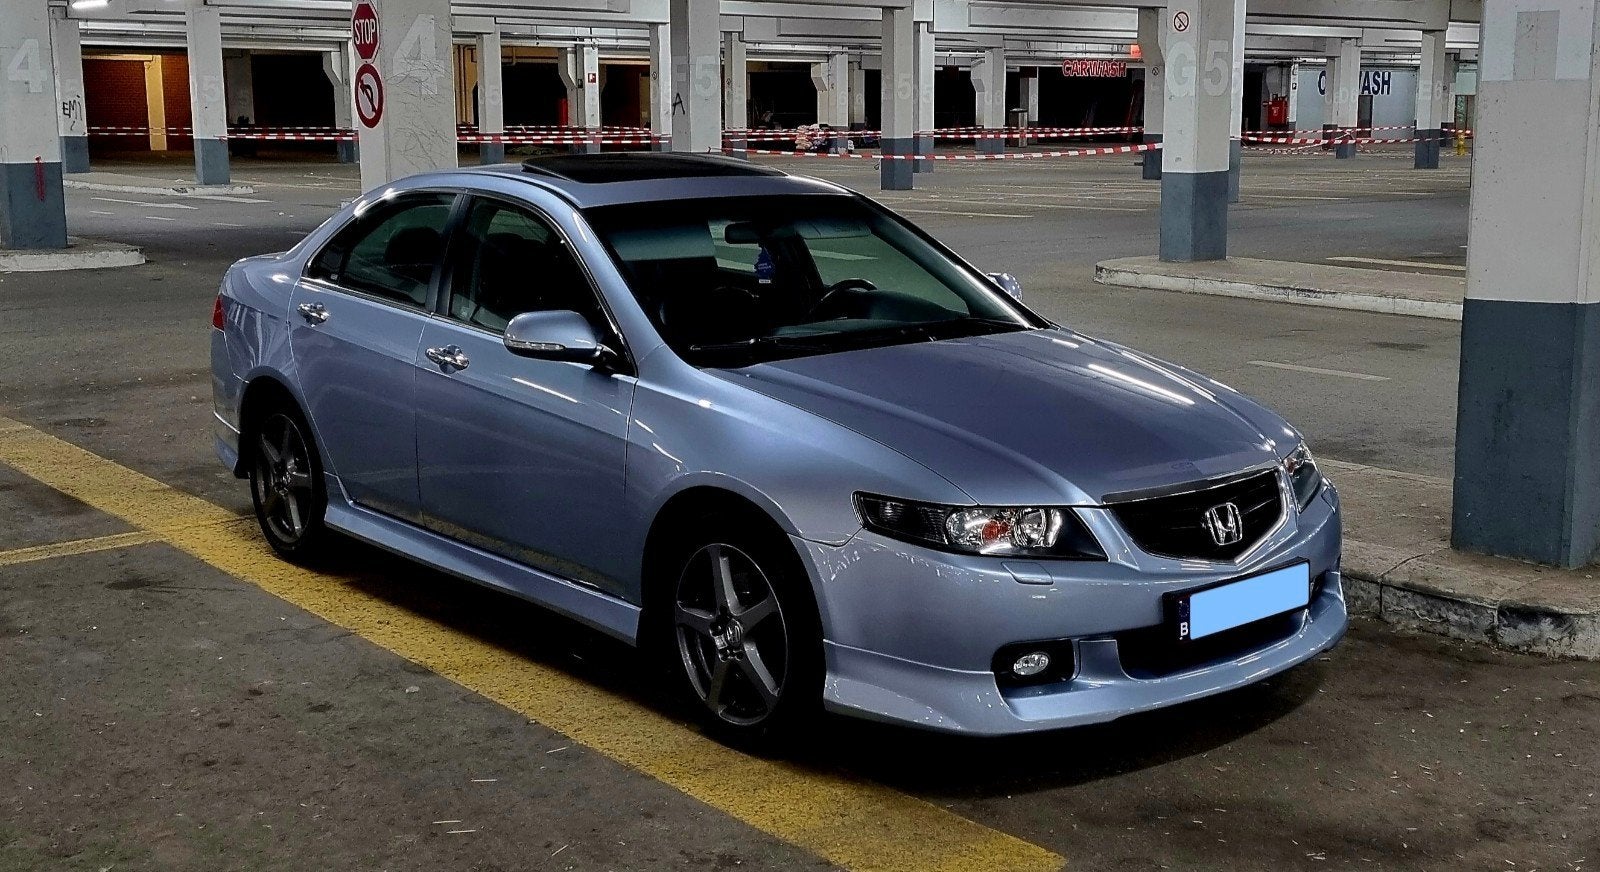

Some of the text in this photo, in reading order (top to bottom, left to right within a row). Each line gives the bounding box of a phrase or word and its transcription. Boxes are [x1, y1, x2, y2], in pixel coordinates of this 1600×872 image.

[354, 18, 376, 45] STOP
[7, 38, 48, 93] 4
[1062, 59, 1127, 77] CARWASH
[1166, 40, 1230, 97] G5
[1180, 621, 1189, 636] B
